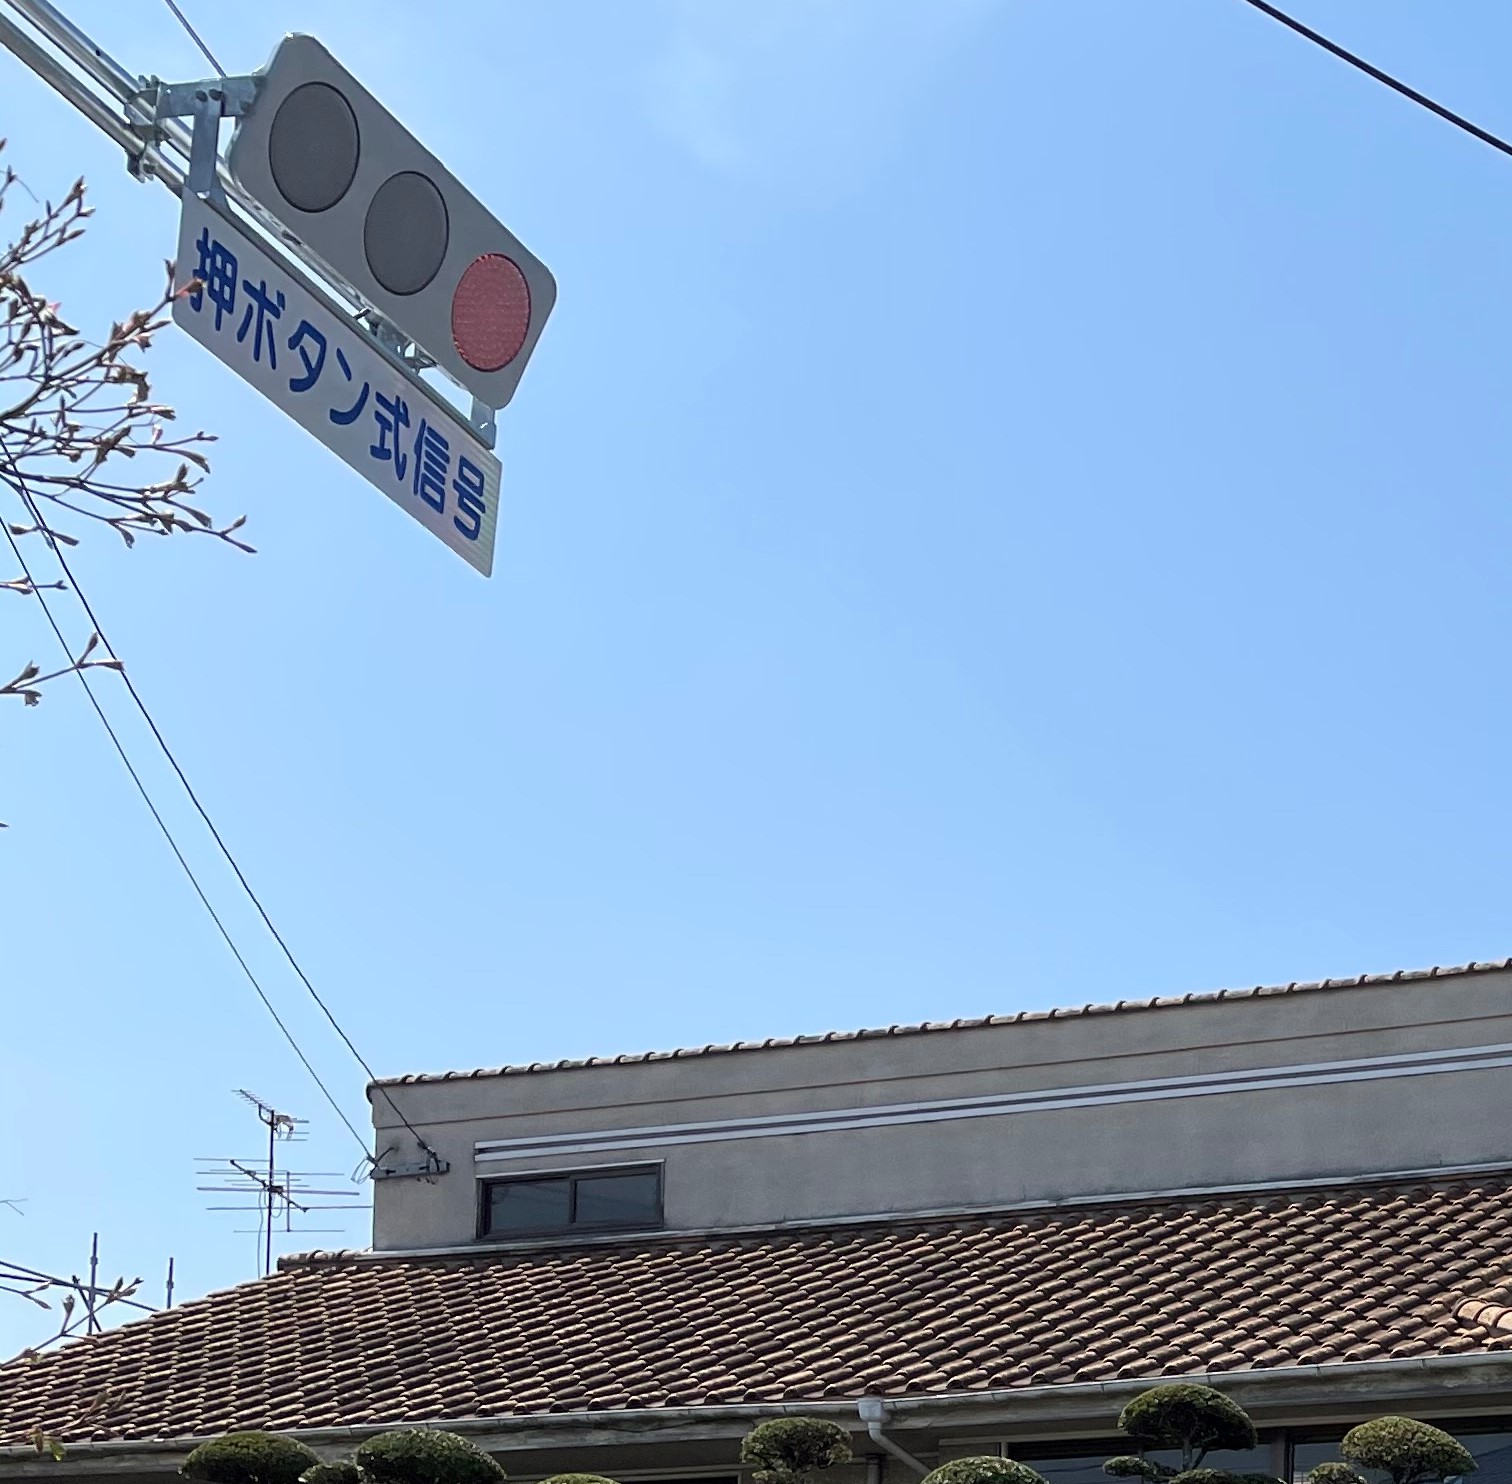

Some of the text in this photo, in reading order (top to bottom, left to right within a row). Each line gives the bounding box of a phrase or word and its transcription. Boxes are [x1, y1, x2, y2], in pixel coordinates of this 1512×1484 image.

[189, 226, 486, 542] 押ボタン式信号
